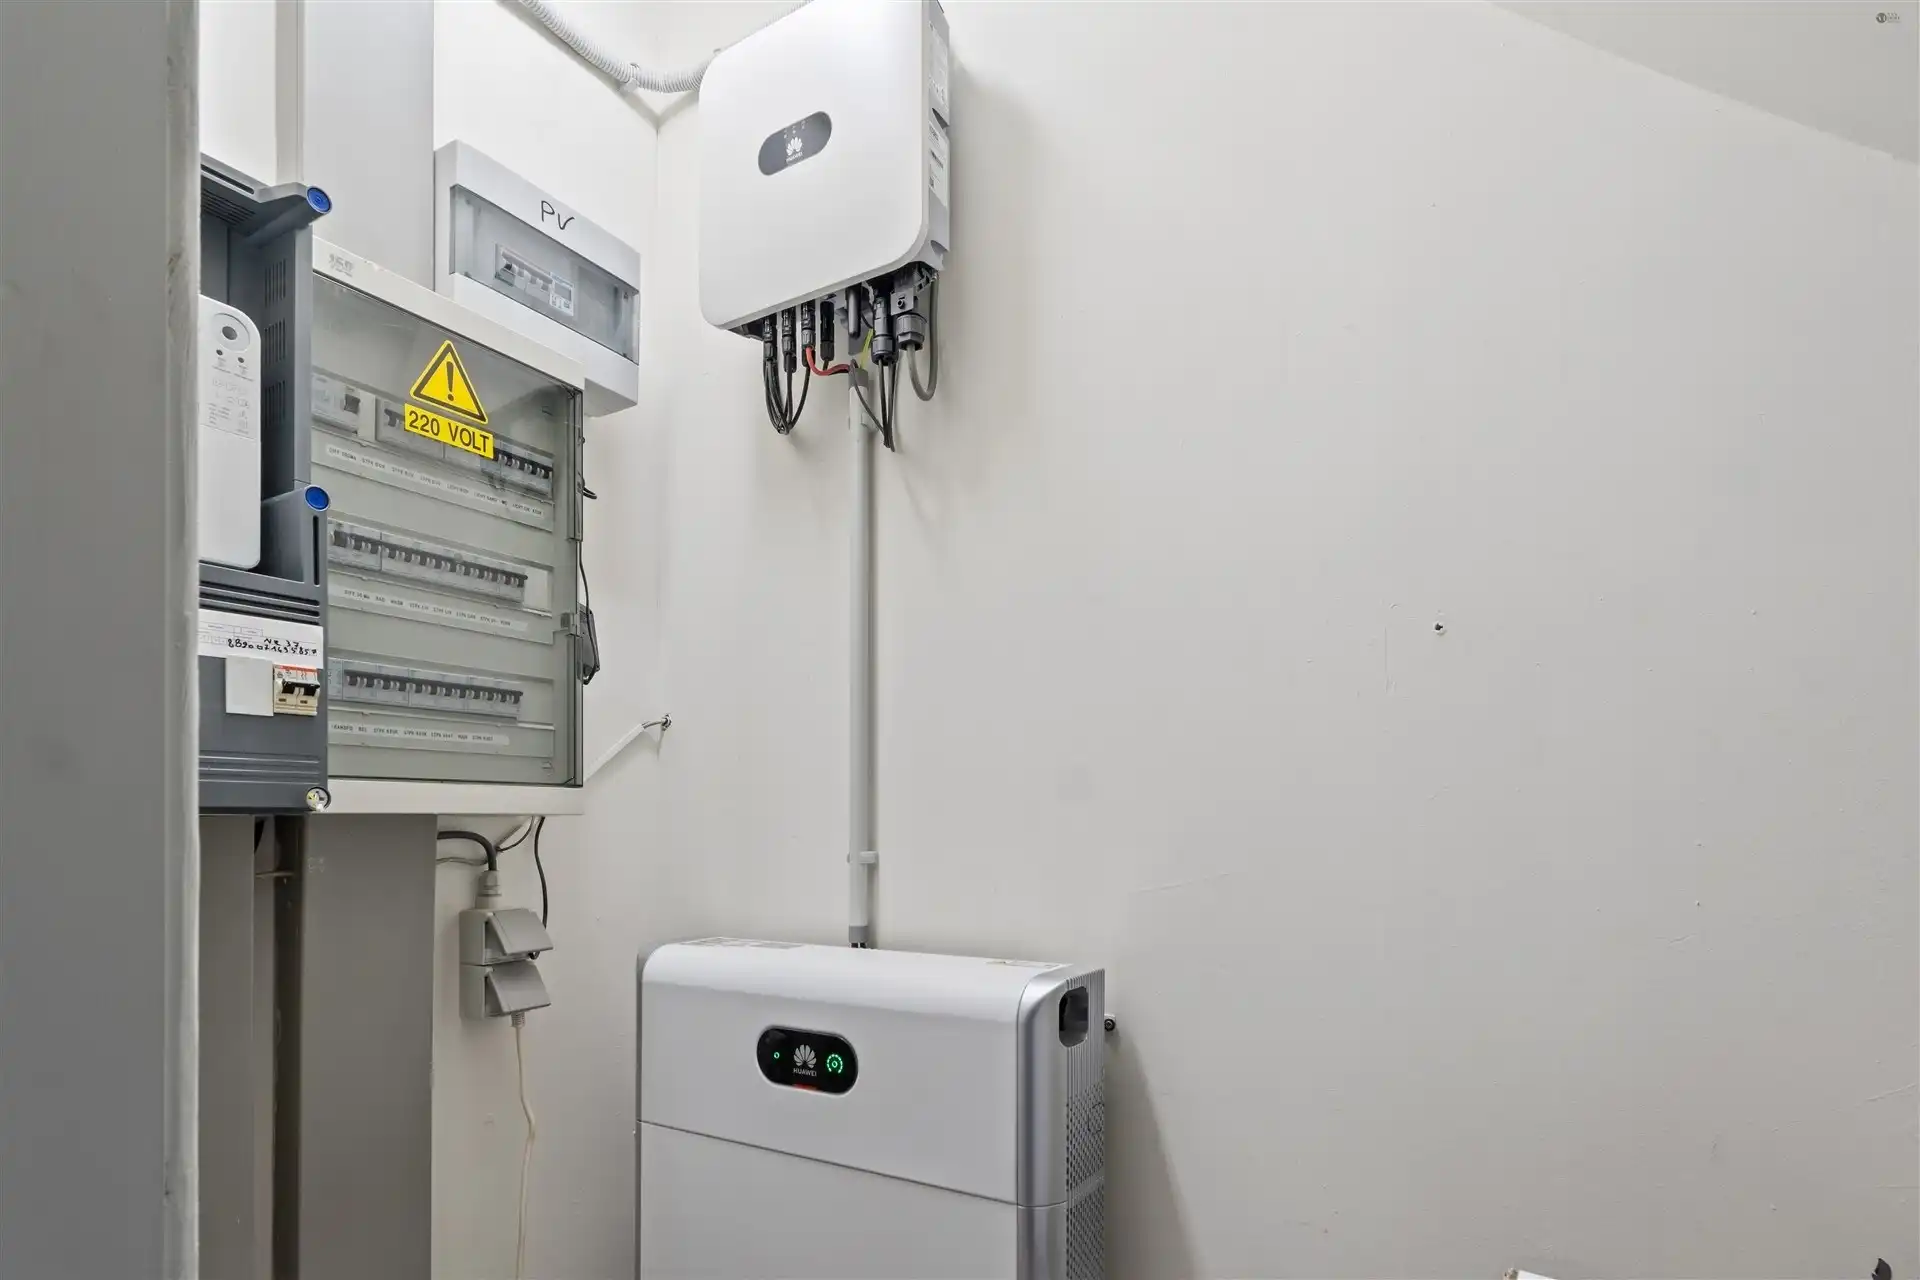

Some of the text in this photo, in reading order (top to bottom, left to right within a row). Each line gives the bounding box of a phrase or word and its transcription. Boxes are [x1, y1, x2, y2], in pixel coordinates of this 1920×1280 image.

[541, 200, 575, 230] PV
[408, 410, 490, 453] 220 VOLT
[793, 1067, 817, 1077] HUAWEI
